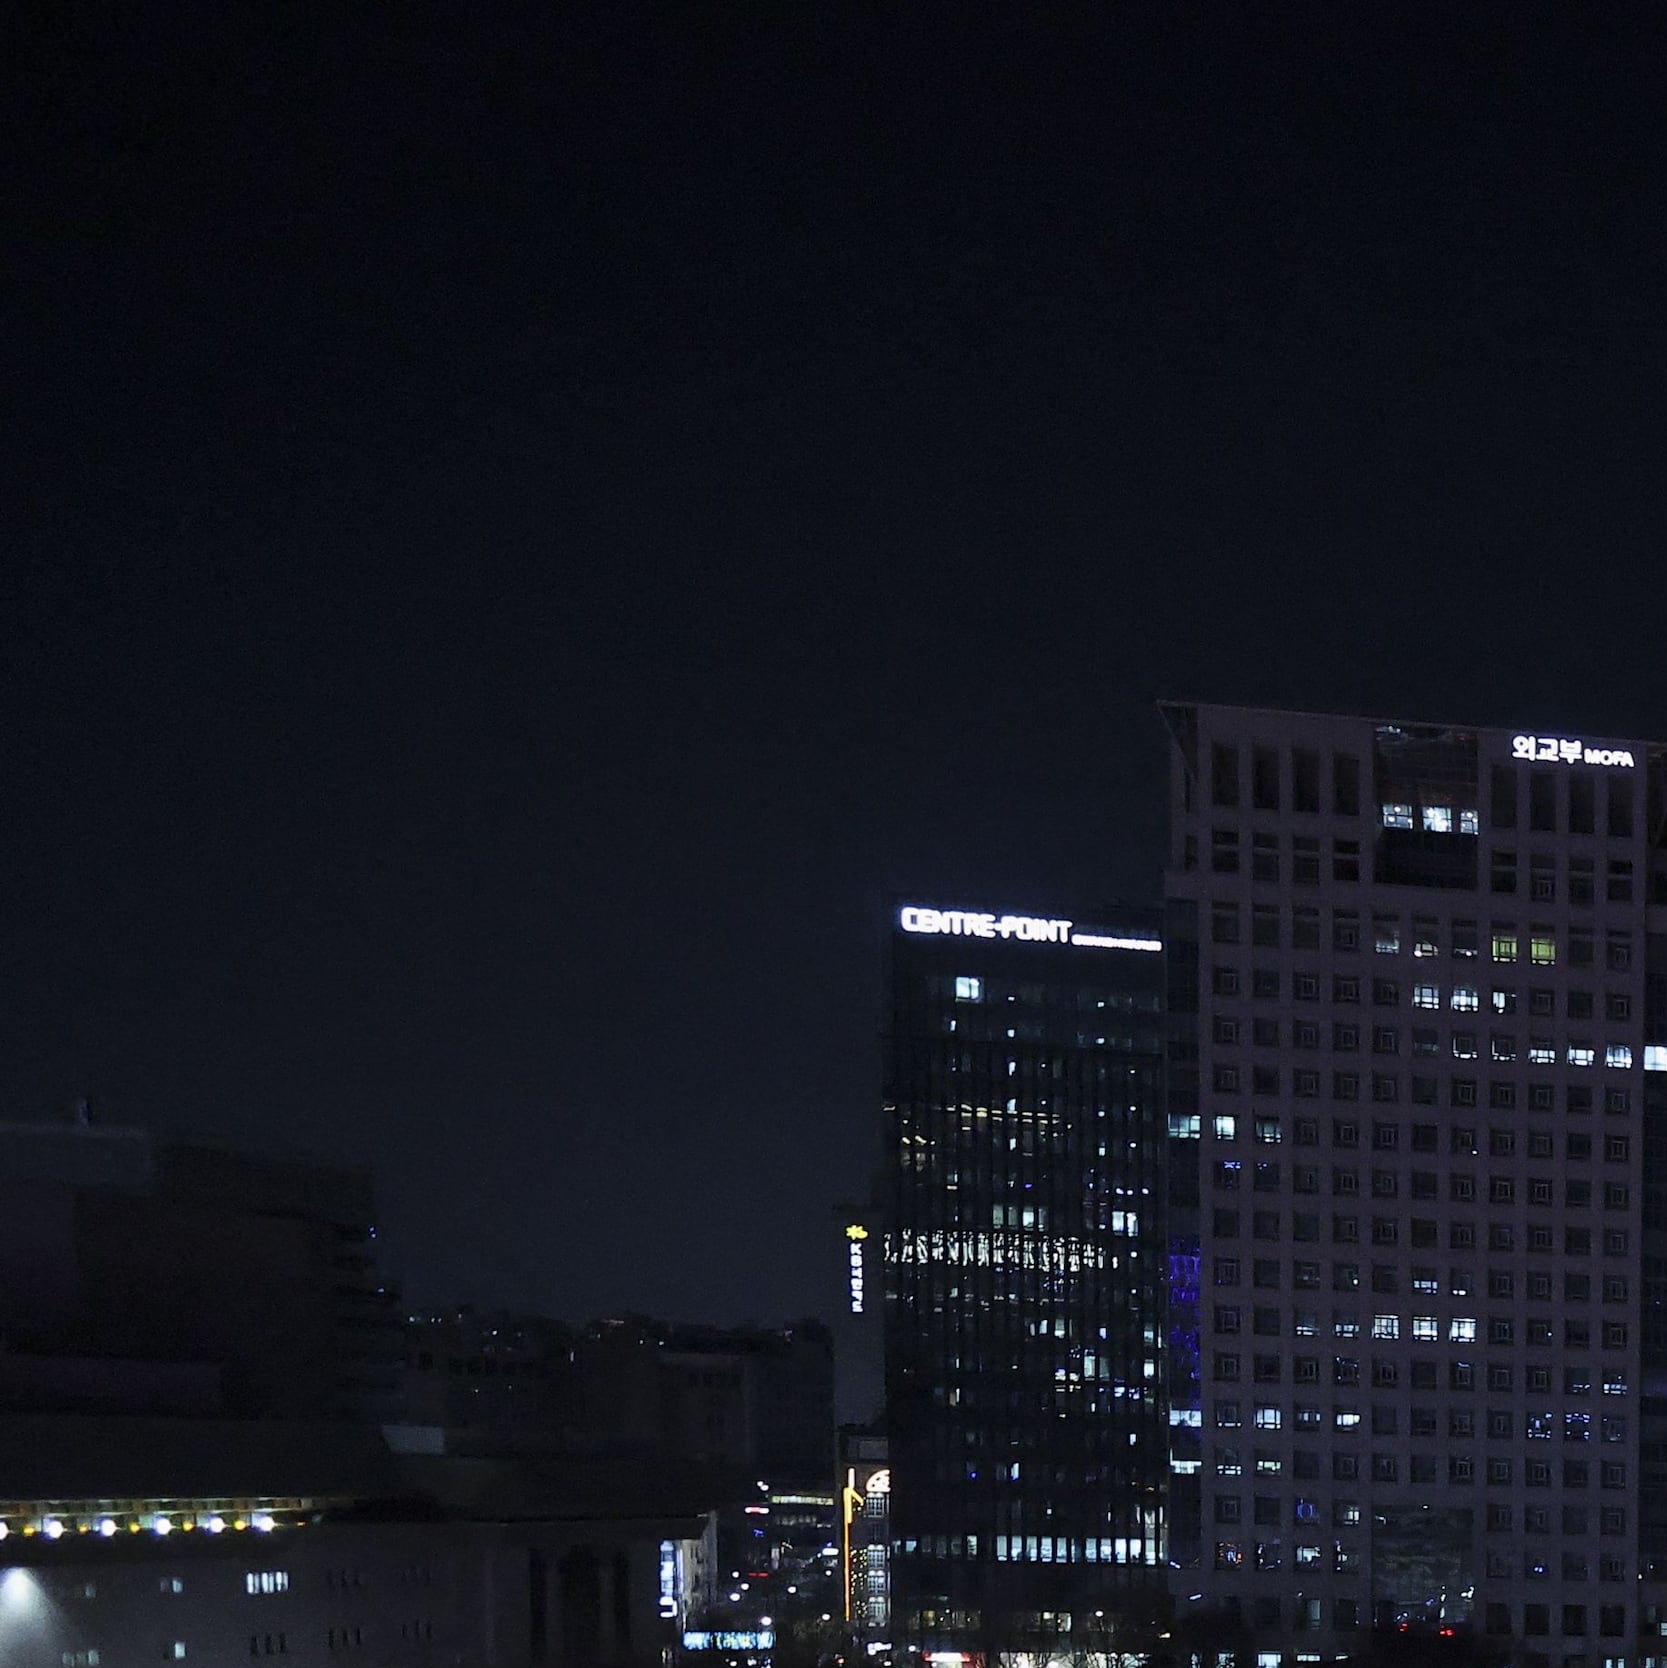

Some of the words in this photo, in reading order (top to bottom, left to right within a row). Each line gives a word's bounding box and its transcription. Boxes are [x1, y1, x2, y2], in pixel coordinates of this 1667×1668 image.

[1512, 735, 1582, 764] 외교부
[1584, 748, 1634, 767] MOFA
[901, 906, 1073, 943] CENTRE-POINT
